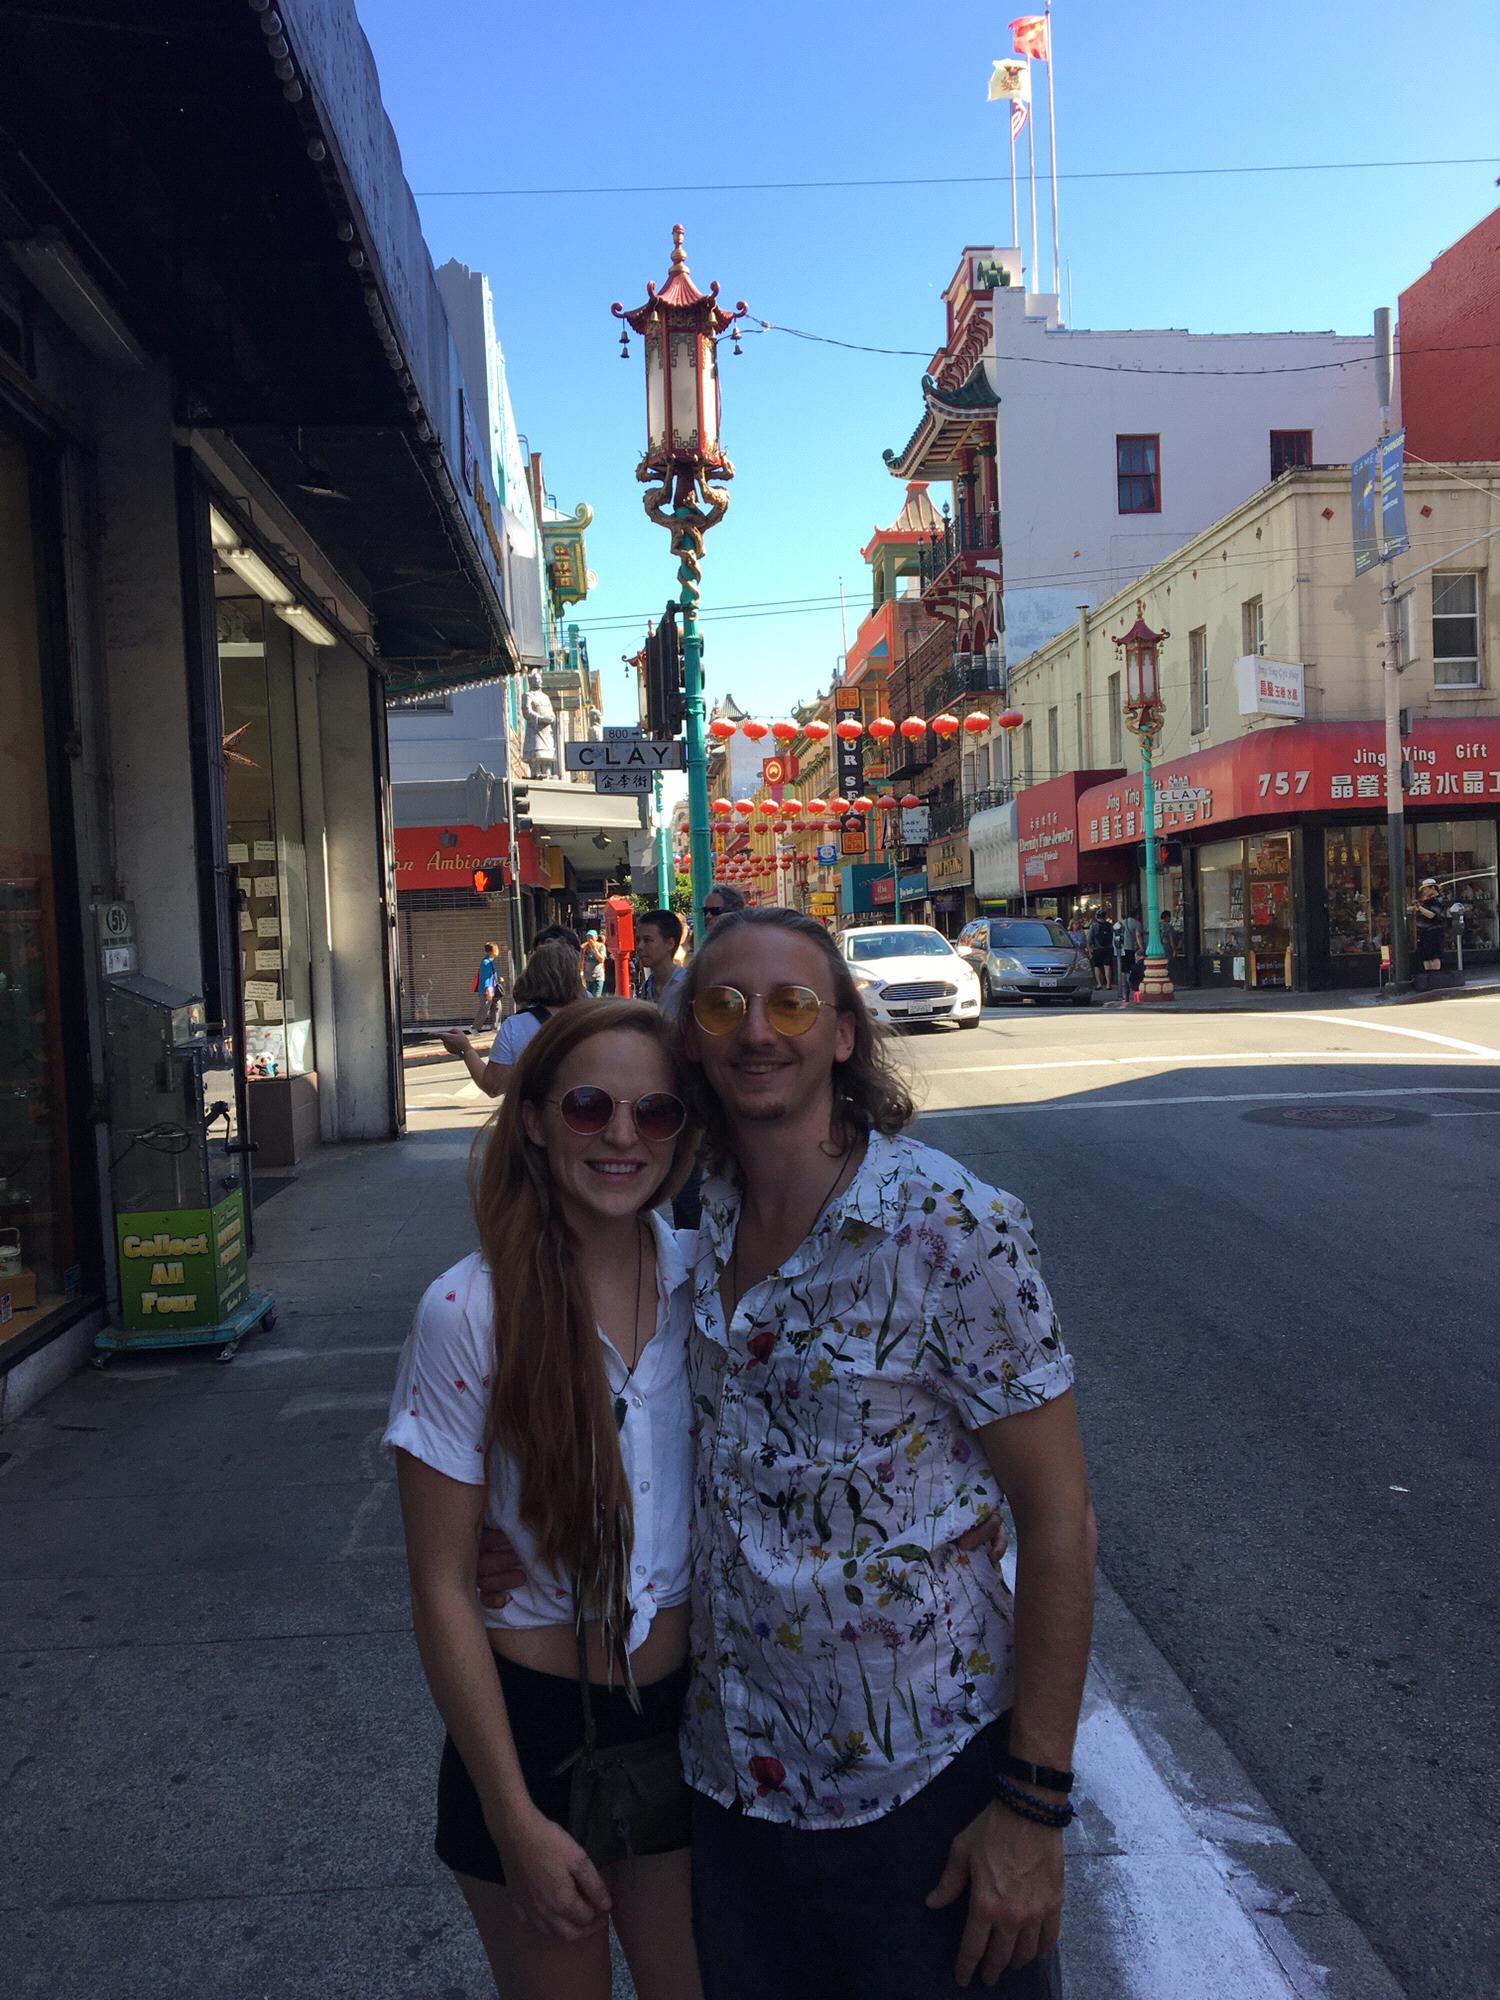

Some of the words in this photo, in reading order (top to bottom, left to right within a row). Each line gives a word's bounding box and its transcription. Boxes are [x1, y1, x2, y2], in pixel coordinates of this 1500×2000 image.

[1353, 453, 1375, 476] GAME
[608, 729, 629, 738] 800
[578, 747, 670, 766] CLAY
[1353, 748, 1387, 767] Jing
[1402, 746, 1436, 765] Ying
[1456, 743, 1492, 759] Gift
[1160, 789, 1201, 801] CLAY
[1258, 770, 1312, 797] 757
[1331, 769, 1500, 799] 晶瑩器水晶工
[1106, 794, 1121, 811] Jing
[1125, 788, 1141, 807] Ying
[122, 1233, 209, 1259] Collect
[150, 1261, 185, 1286] All
[140, 1291, 198, 1315] Four
